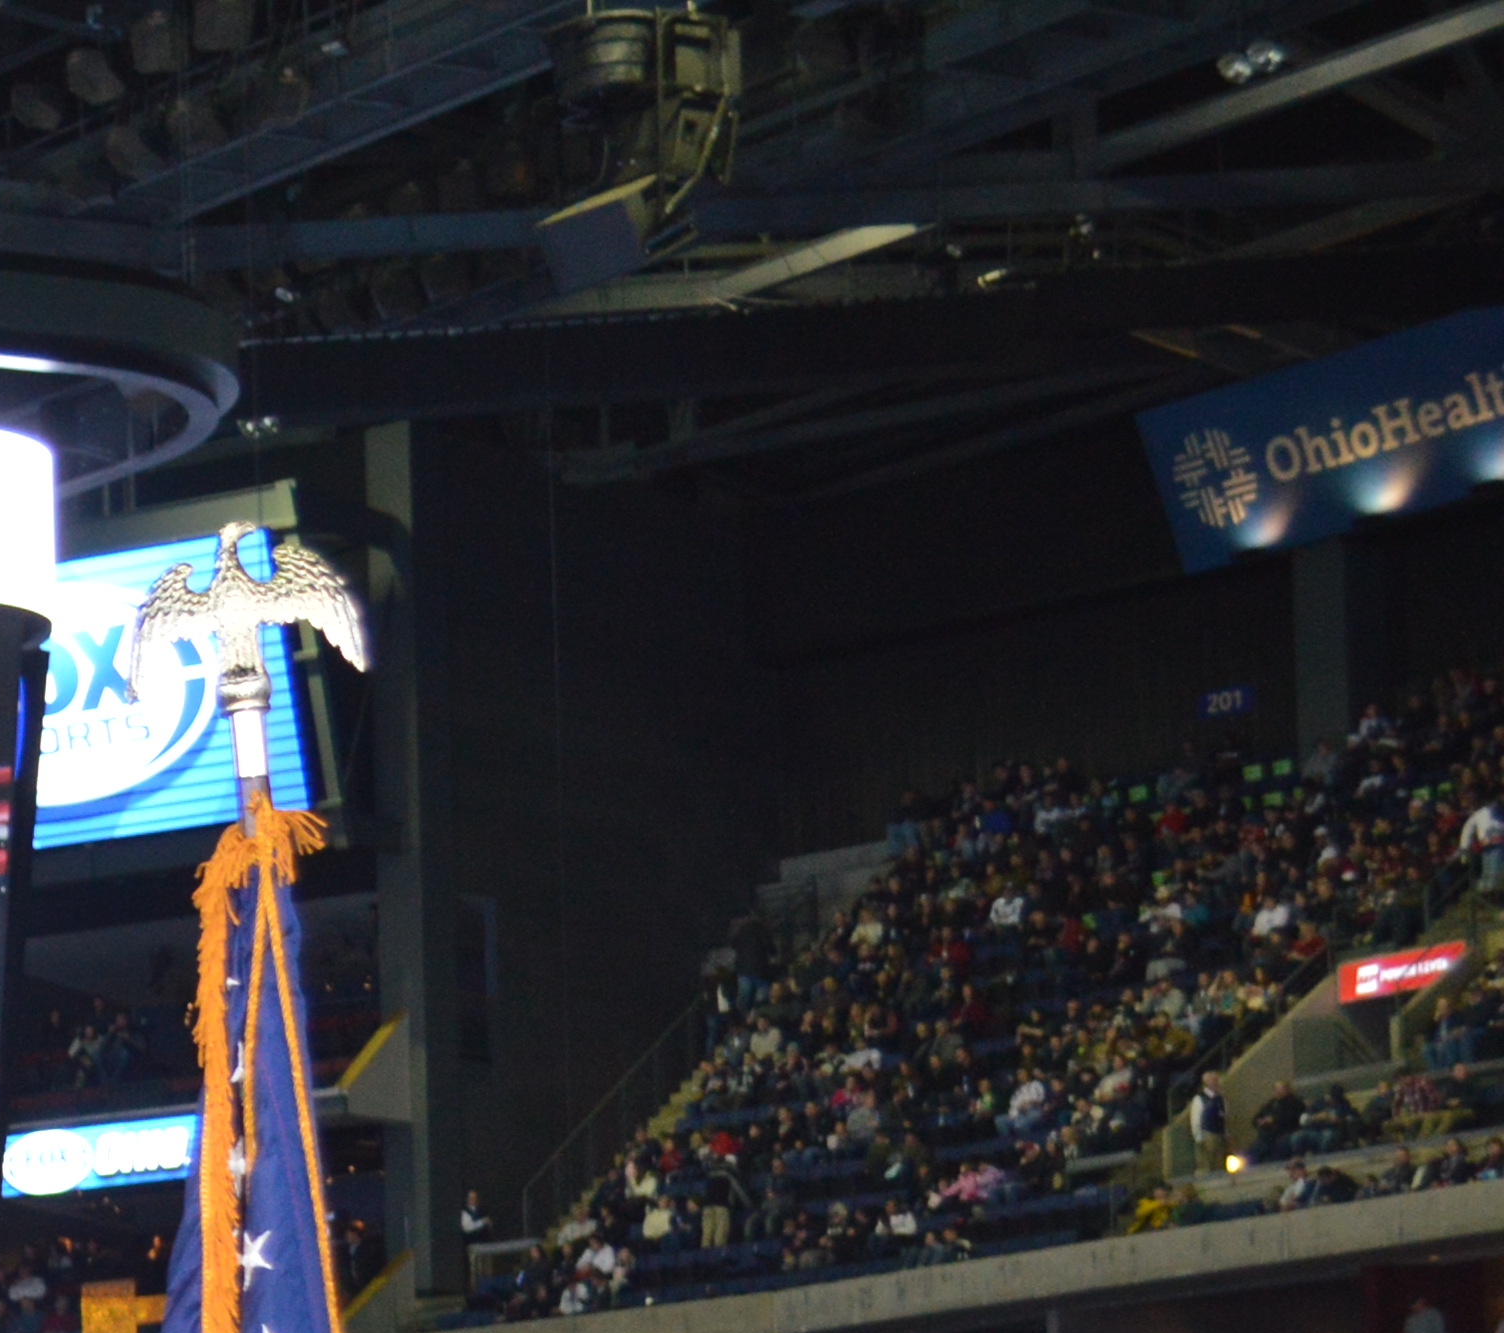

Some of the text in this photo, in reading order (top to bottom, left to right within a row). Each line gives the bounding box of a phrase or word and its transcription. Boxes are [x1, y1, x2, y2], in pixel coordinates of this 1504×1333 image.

[1265, 370, 1504, 482] OhioHealt
[43, 624, 138, 716] OX
[1207, 689, 1243, 714] 201
